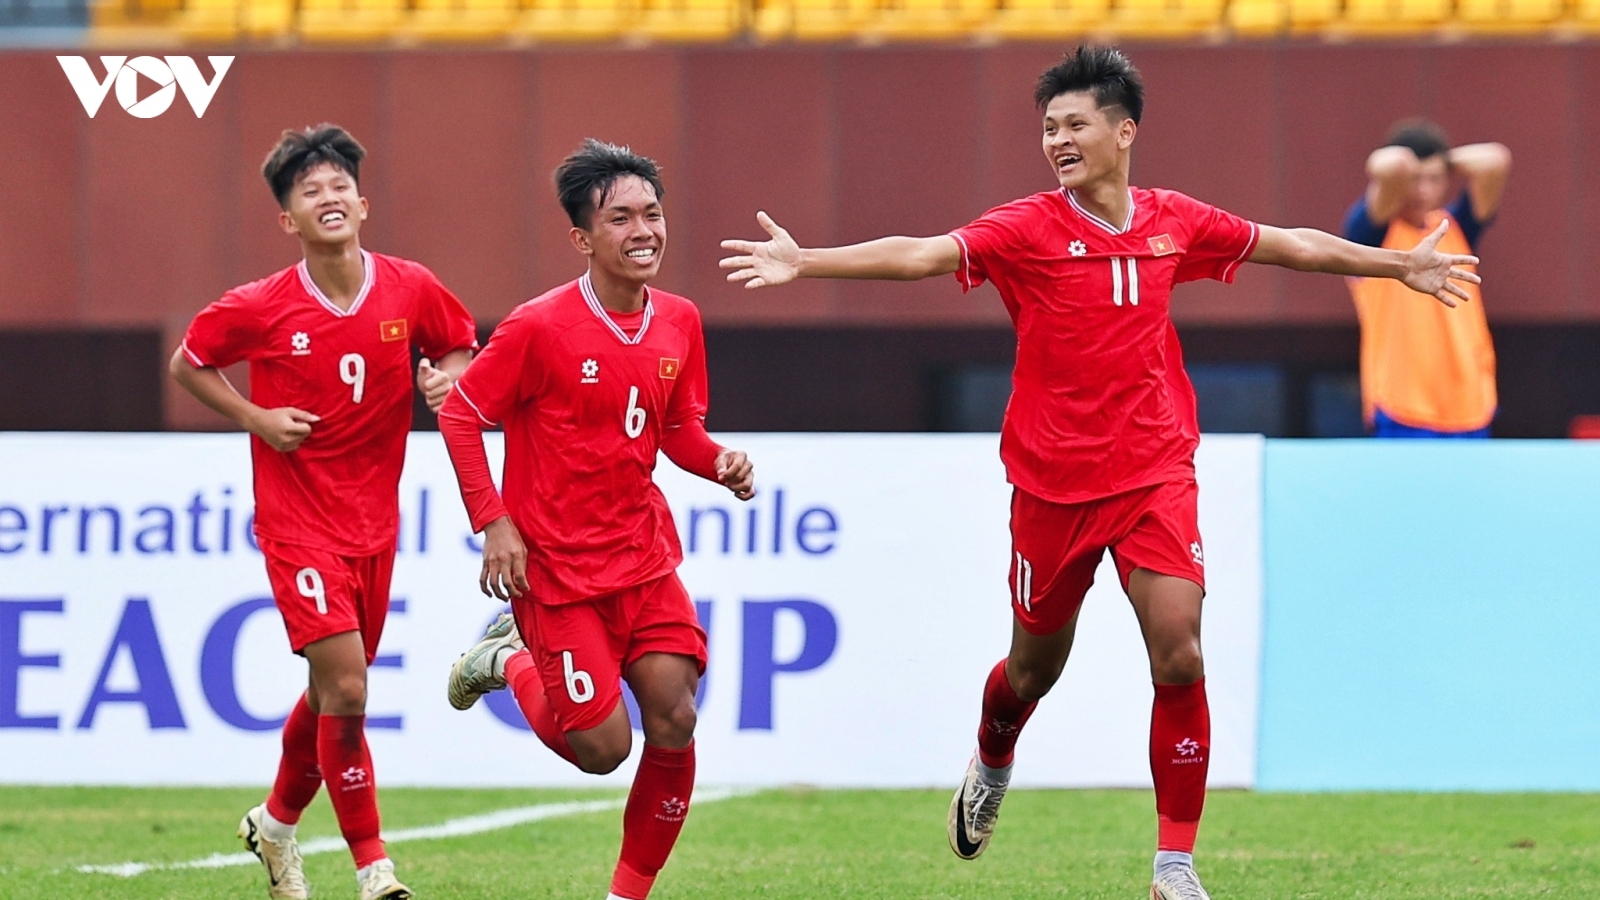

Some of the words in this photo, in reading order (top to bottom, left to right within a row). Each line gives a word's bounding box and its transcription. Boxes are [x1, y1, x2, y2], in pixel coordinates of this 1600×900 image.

[1110, 256, 1139, 306] 11
[339, 353, 365, 404] 9
[625, 385, 647, 439] 6
[0, 487, 429, 553] ernatil
[296, 567, 328, 615] 9
[1016, 551, 1032, 612] 11
[563, 650, 595, 703] 6
